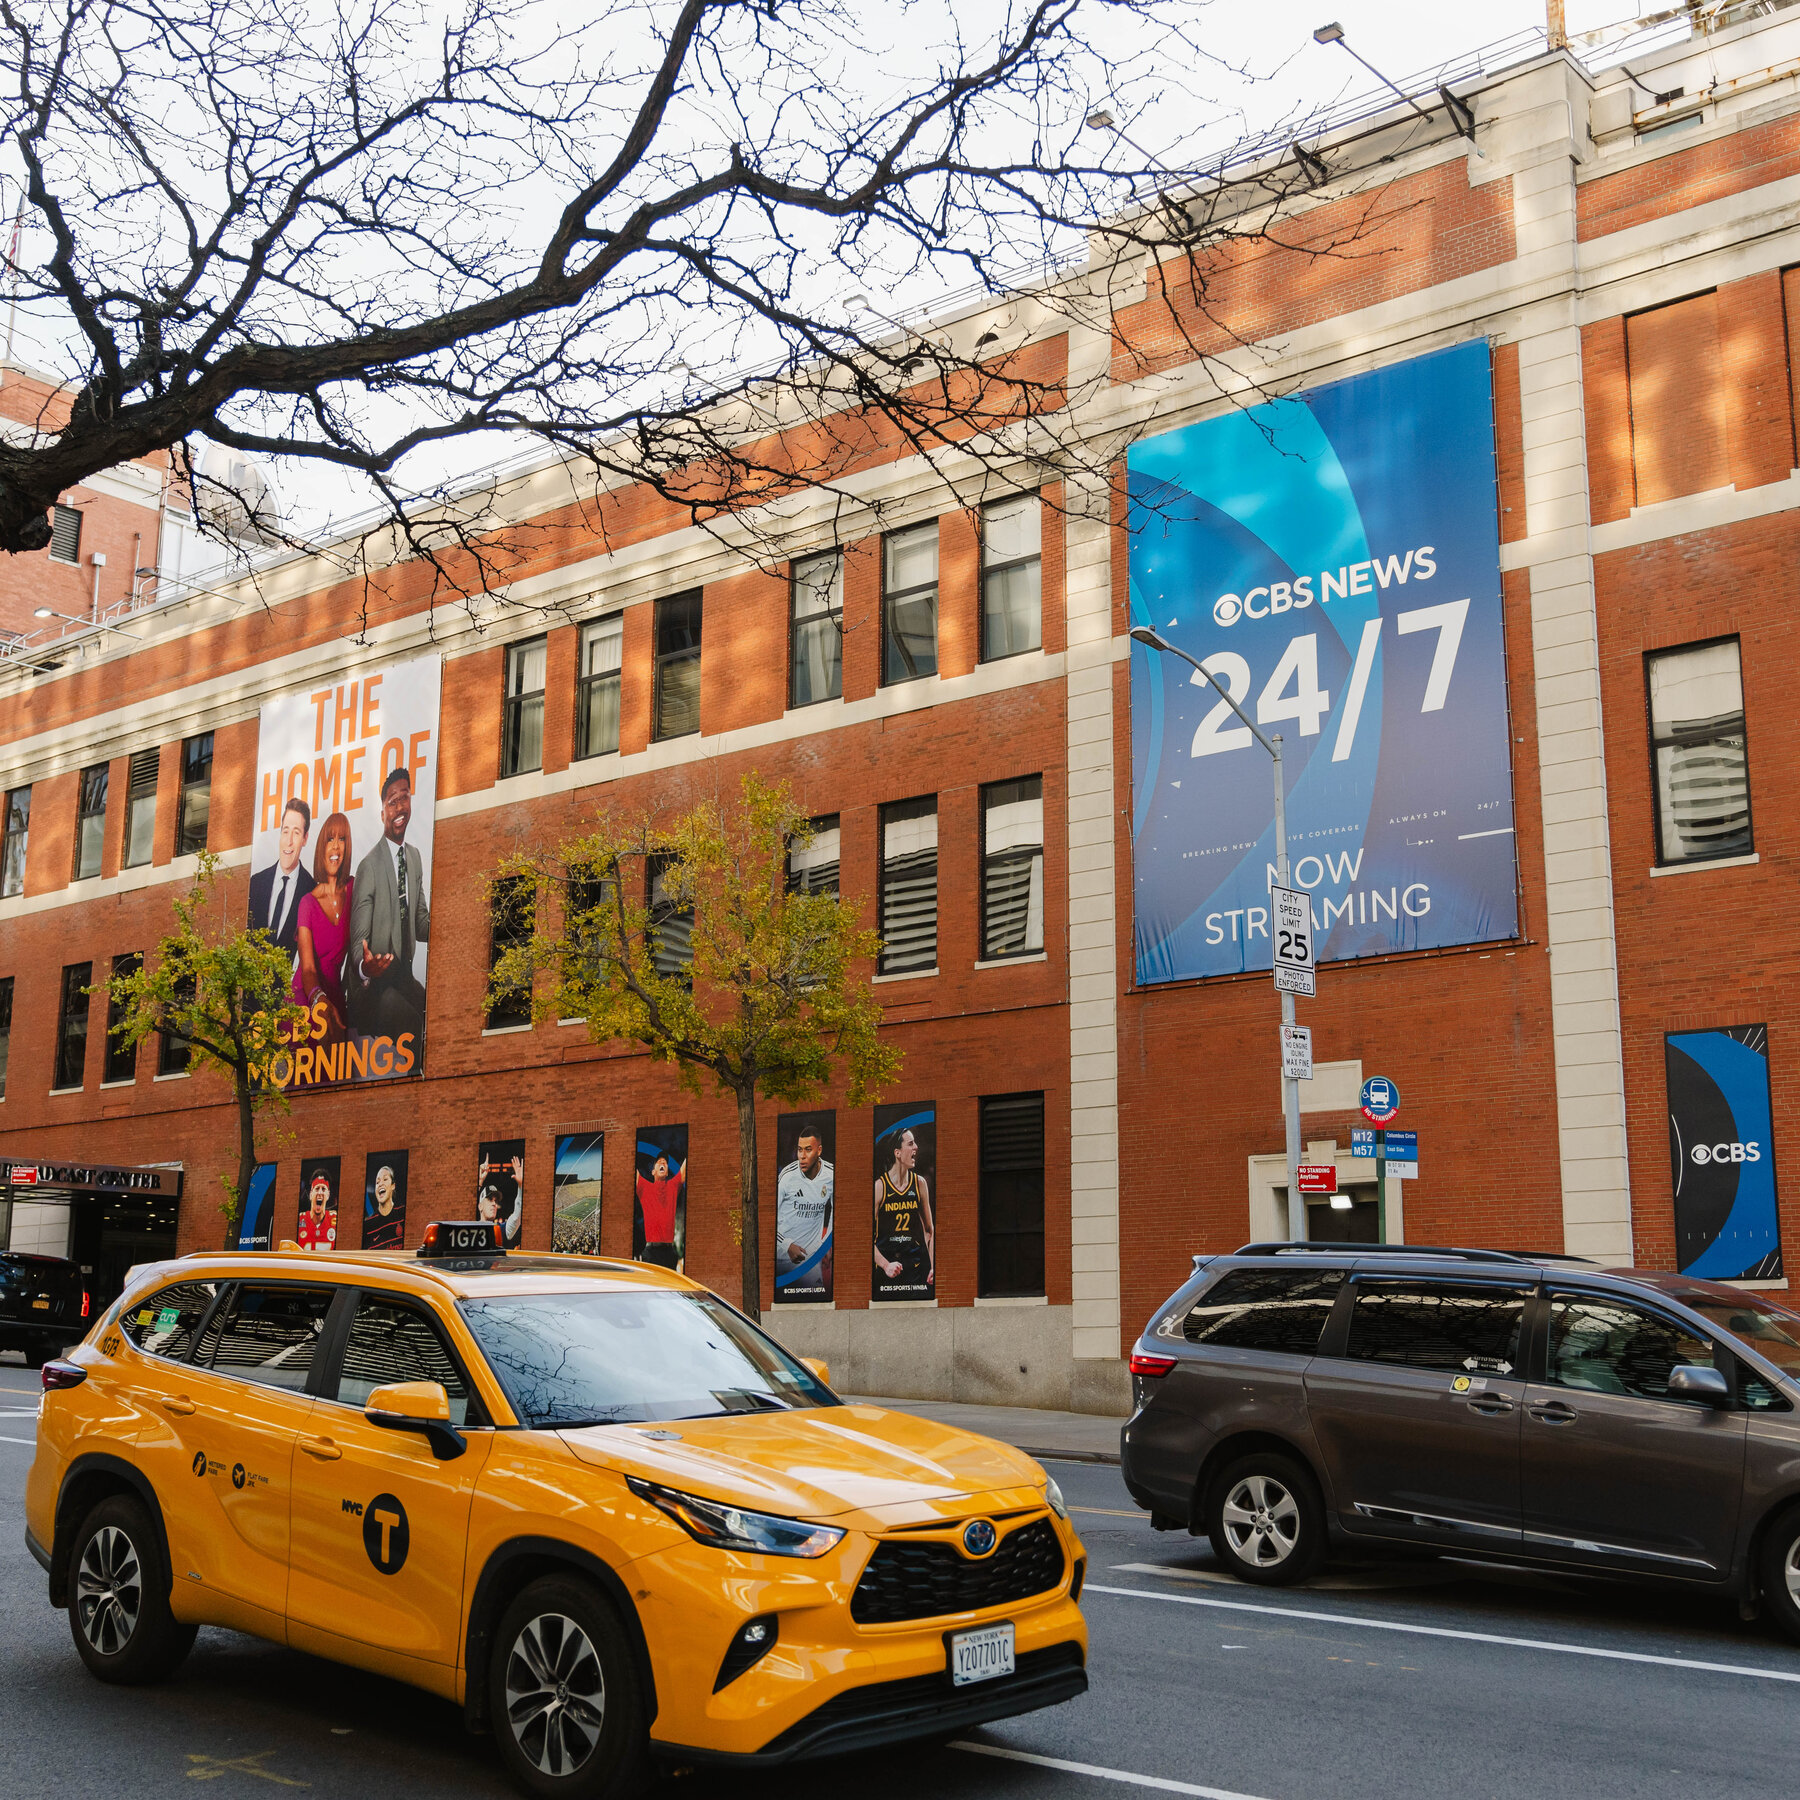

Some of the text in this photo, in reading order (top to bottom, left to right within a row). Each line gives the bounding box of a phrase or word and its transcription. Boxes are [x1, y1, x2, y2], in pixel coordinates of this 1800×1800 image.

[1244, 546, 1437, 619] CBS NEWS
[1189, 598, 1470, 763] 24/7
[311, 674, 383, 752] THE
[261, 730, 431, 832] HOME OF
[1477, 800, 1500, 810] 24/7
[1389, 809, 1447, 824] ALWAYS ON
[1308, 823, 1360, 838] COVERAGE
[1182, 840, 1257, 859] BREAKING NEWS
[1267, 848, 1364, 894] NOW
[1282, 893, 1299, 904] CITY
[1279, 904, 1303, 917] SPEED
[1282, 917, 1301, 929] LIMIT
[1278, 930, 1309, 962] 25
[1283, 970, 1305, 982] PHOTO
[1278, 977, 1312, 992] ENFORCED
[1285, 1041, 1308, 1051] NO ENGINE
[248, 1032, 416, 1090] MORNINGS
[1286, 1058, 1310, 1068] MAX FINE
[1364, 1107, 1397, 1121] NO STANDING
[1353, 1131, 1373, 1142] M12
[1353, 1145, 1373, 1156] M57
[1712, 1141, 1761, 1163] CBS
[96, 1169, 161, 1189] CENTER
[793, 1200, 825, 1211] Emirates
[885, 1201, 918, 1211] INDIANA
[895, 1212, 910, 1231] 22
[449, 1229, 487, 1247] 1G73
[101, 1336, 120, 1357] 1G73
[208, 1460, 227, 1470] METERED
[247, 1472, 269, 1484] FLAT FARE
[341, 1498, 400, 1564] NYC T
[968, 1631, 999, 1643] NEW YORK
[958, 1639, 1009, 1672] Y207701C
